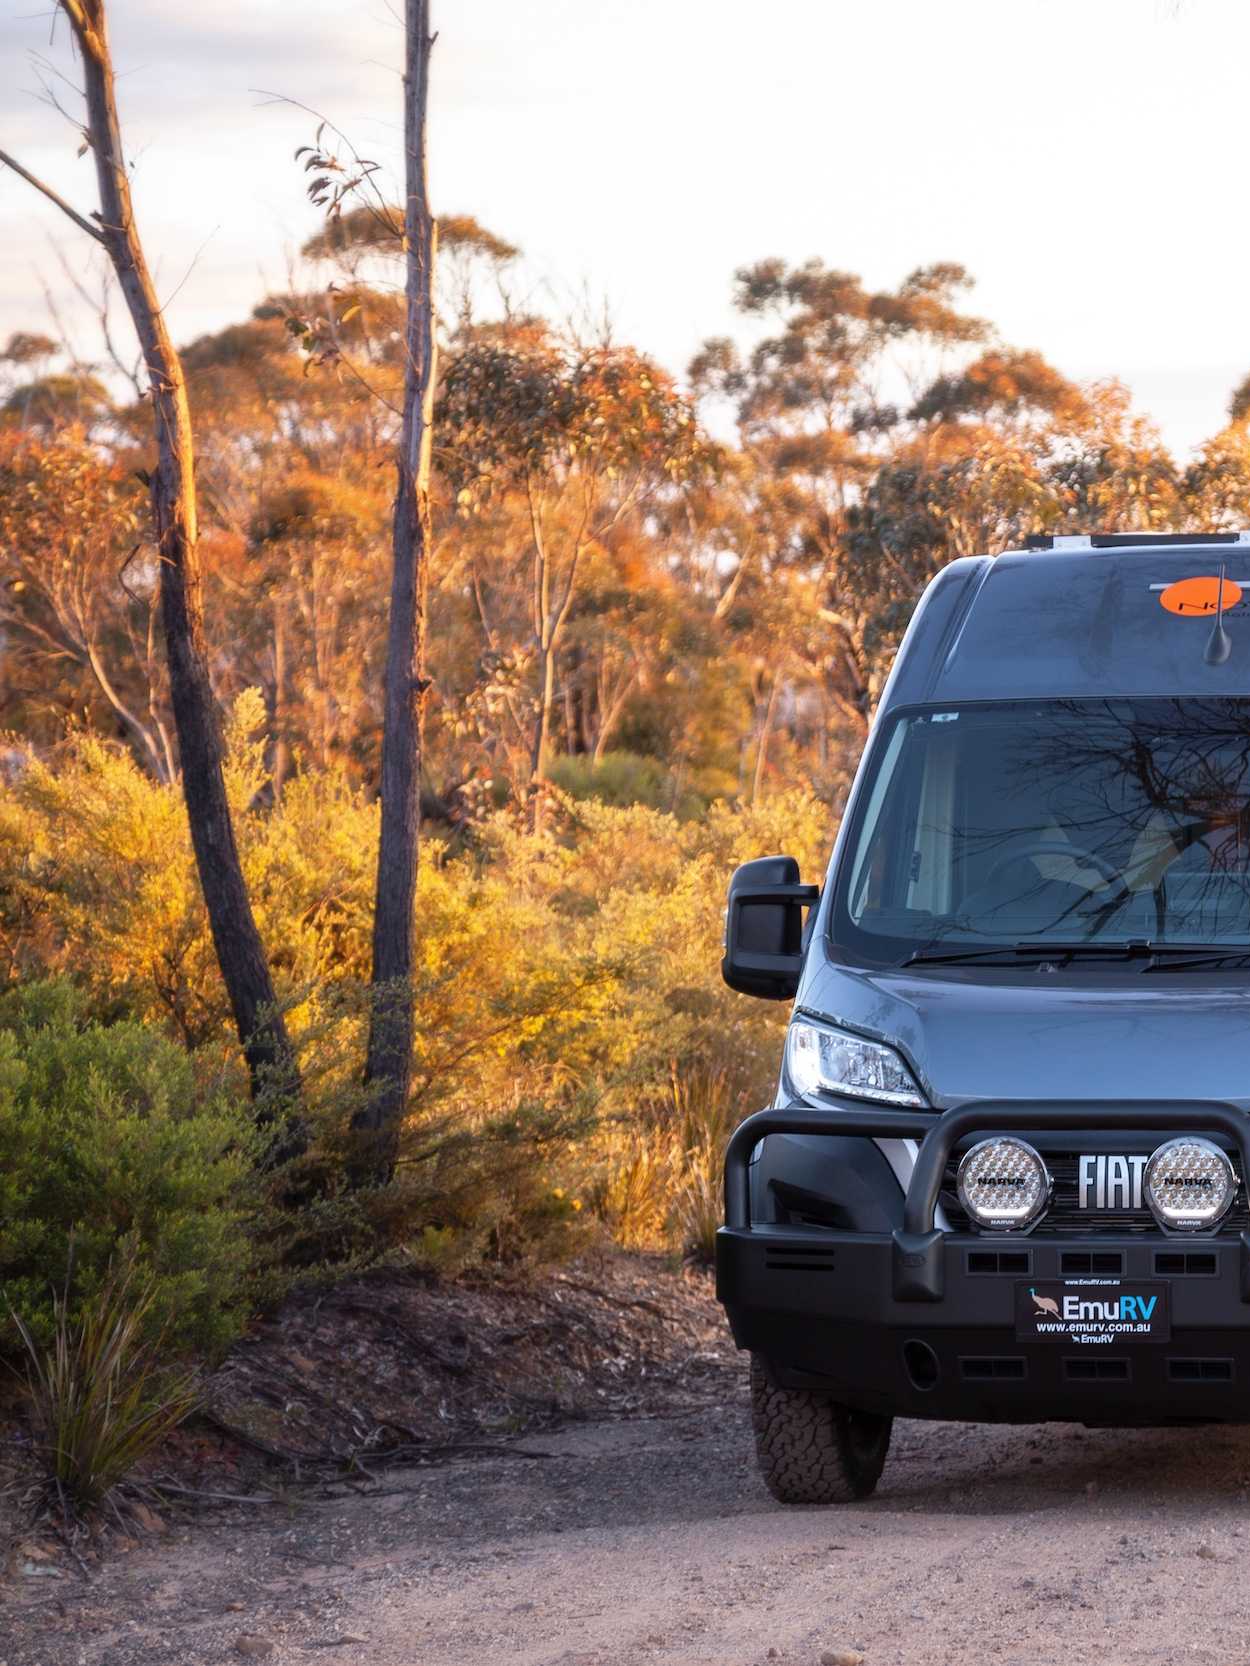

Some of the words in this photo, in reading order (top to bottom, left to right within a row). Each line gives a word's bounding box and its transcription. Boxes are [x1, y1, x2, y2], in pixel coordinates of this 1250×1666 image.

[978, 1177, 1025, 1186] NARVA
[1079, 1155, 1148, 1208] FIAT
[1165, 1178, 1212, 1186] NARVA
[1063, 1296, 1157, 1320] EmuRV
[1037, 1322, 1151, 1332] www.emurv.com.au
[1081, 1334, 1114, 1344] EmuRV
